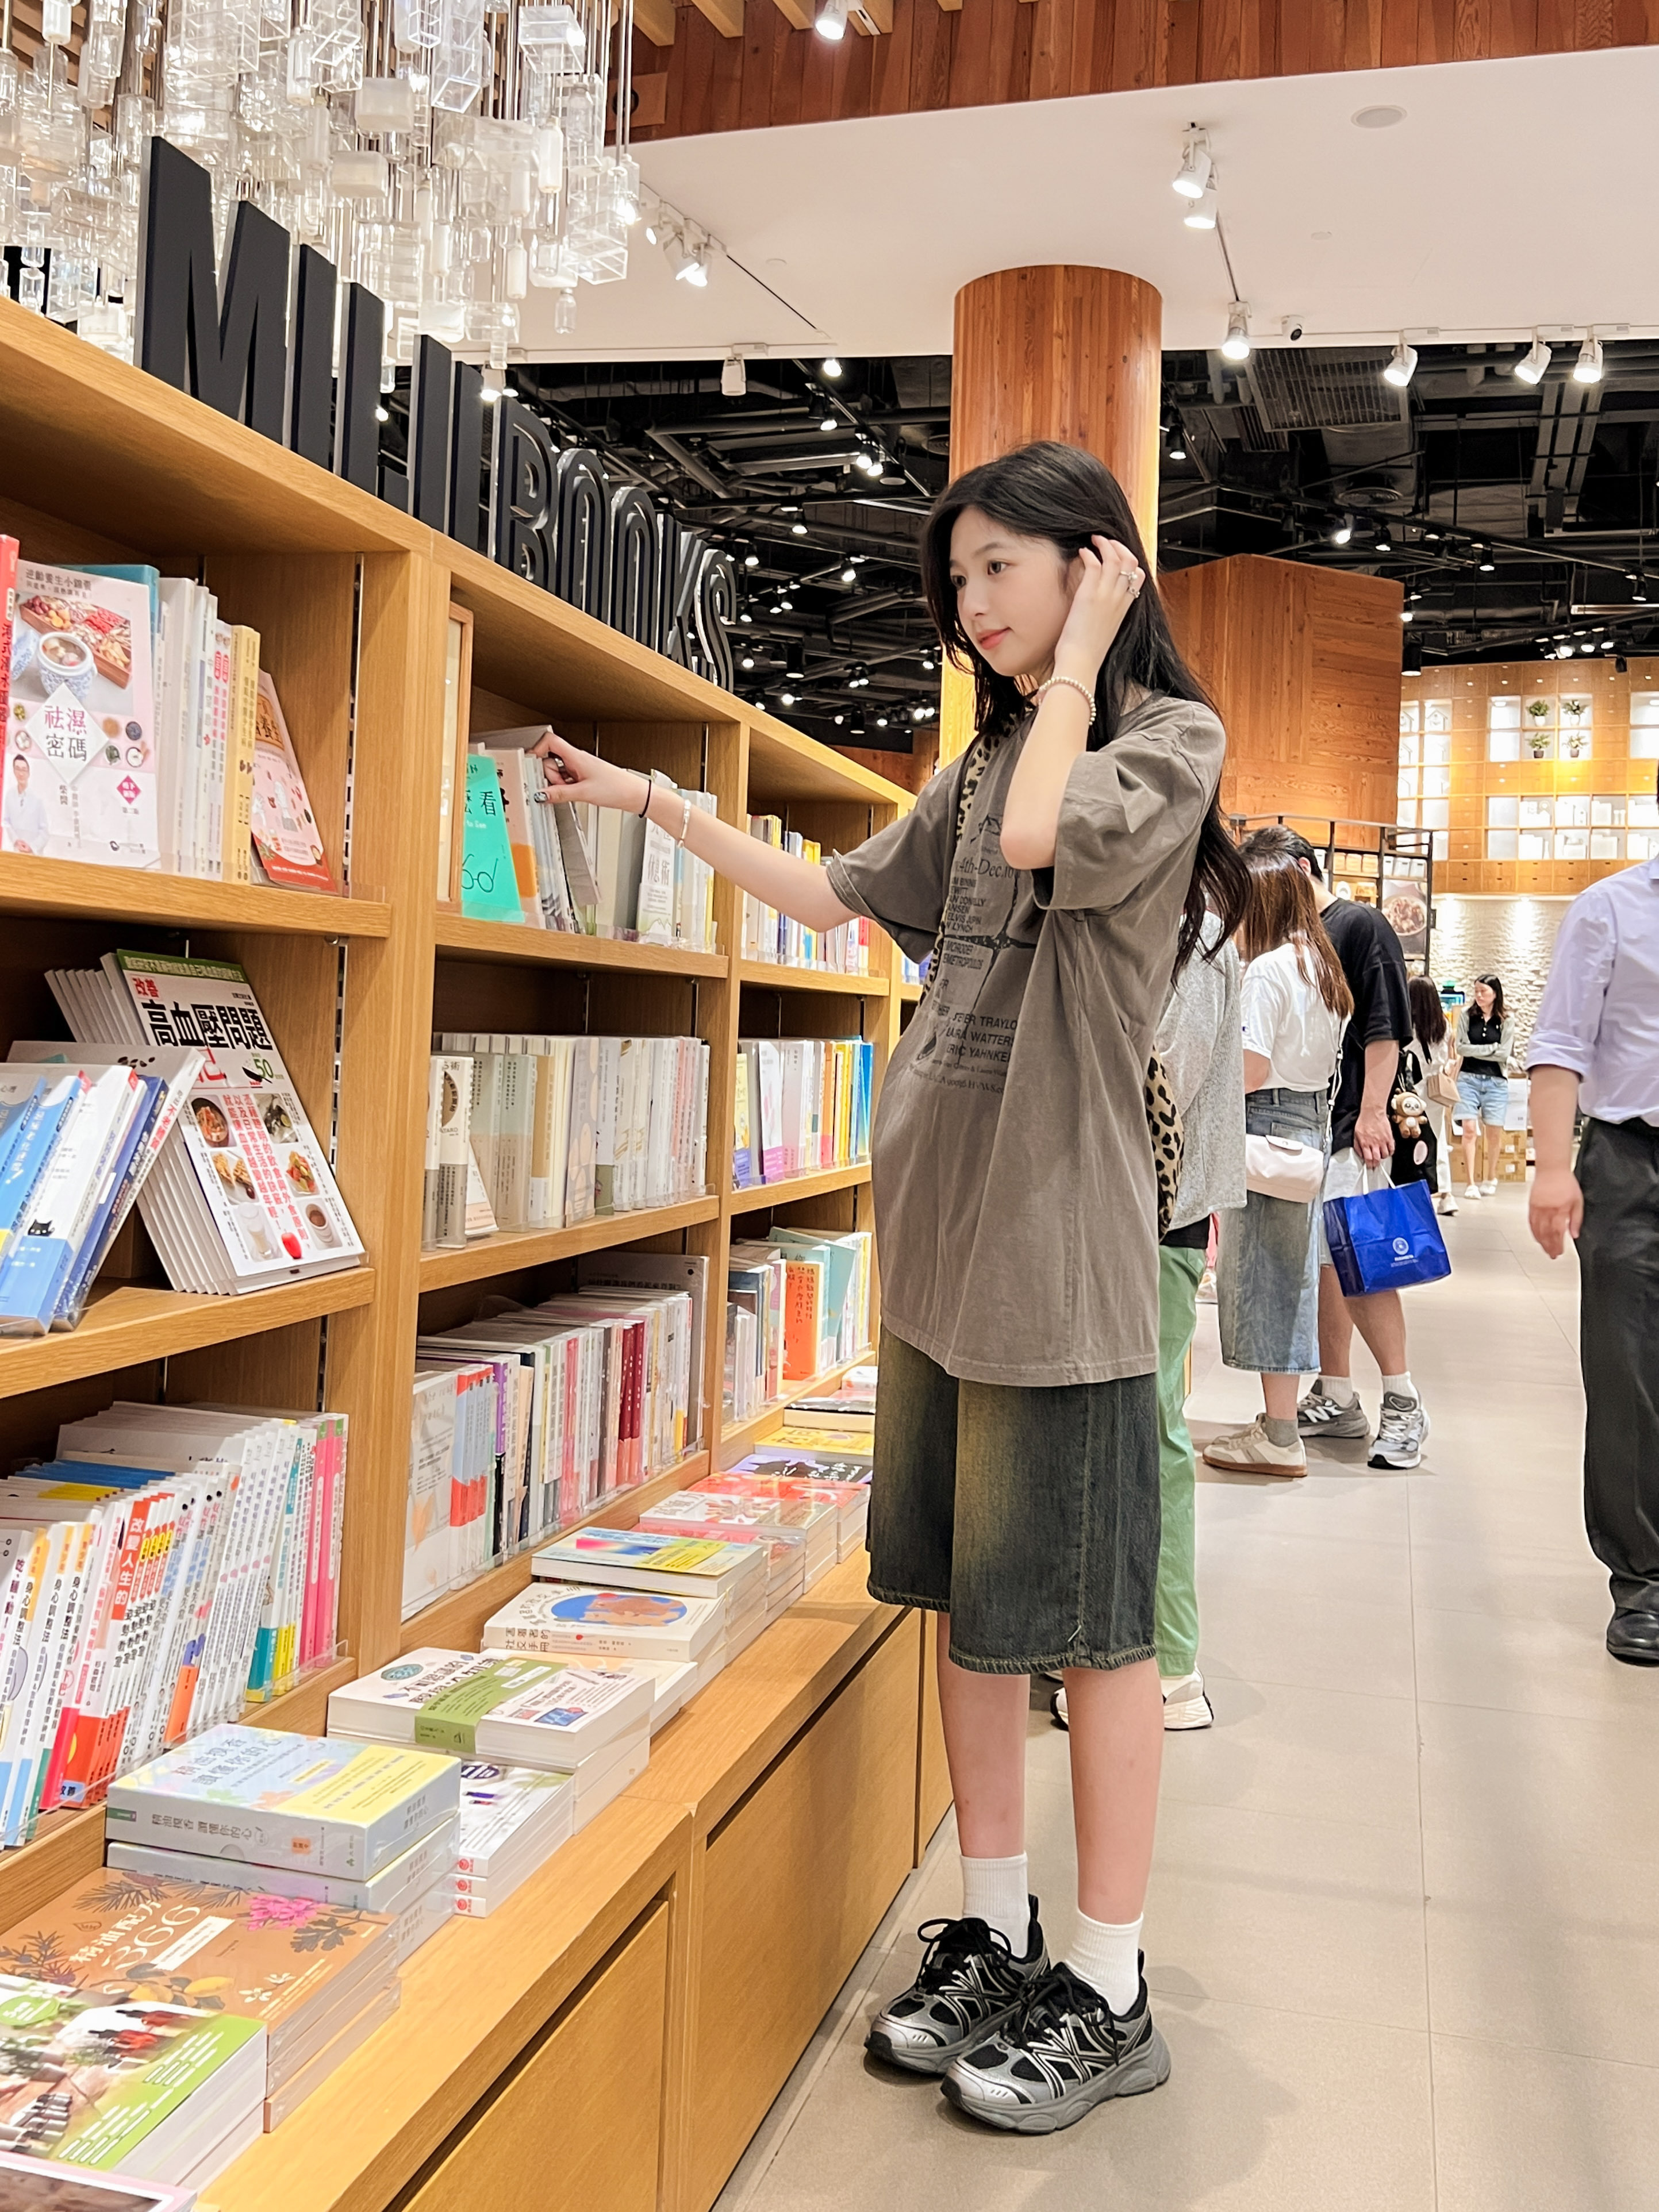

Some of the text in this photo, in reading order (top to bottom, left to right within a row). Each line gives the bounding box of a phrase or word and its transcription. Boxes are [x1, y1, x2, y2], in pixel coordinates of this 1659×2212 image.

[45, 733, 87, 761] 密碼
[141, 999, 274, 1051] 高血壓問題
[254, 1059, 274, 1079] 50
[114, 1517, 145, 1606] 改變人生的
[101, 1905, 200, 1971] 366
